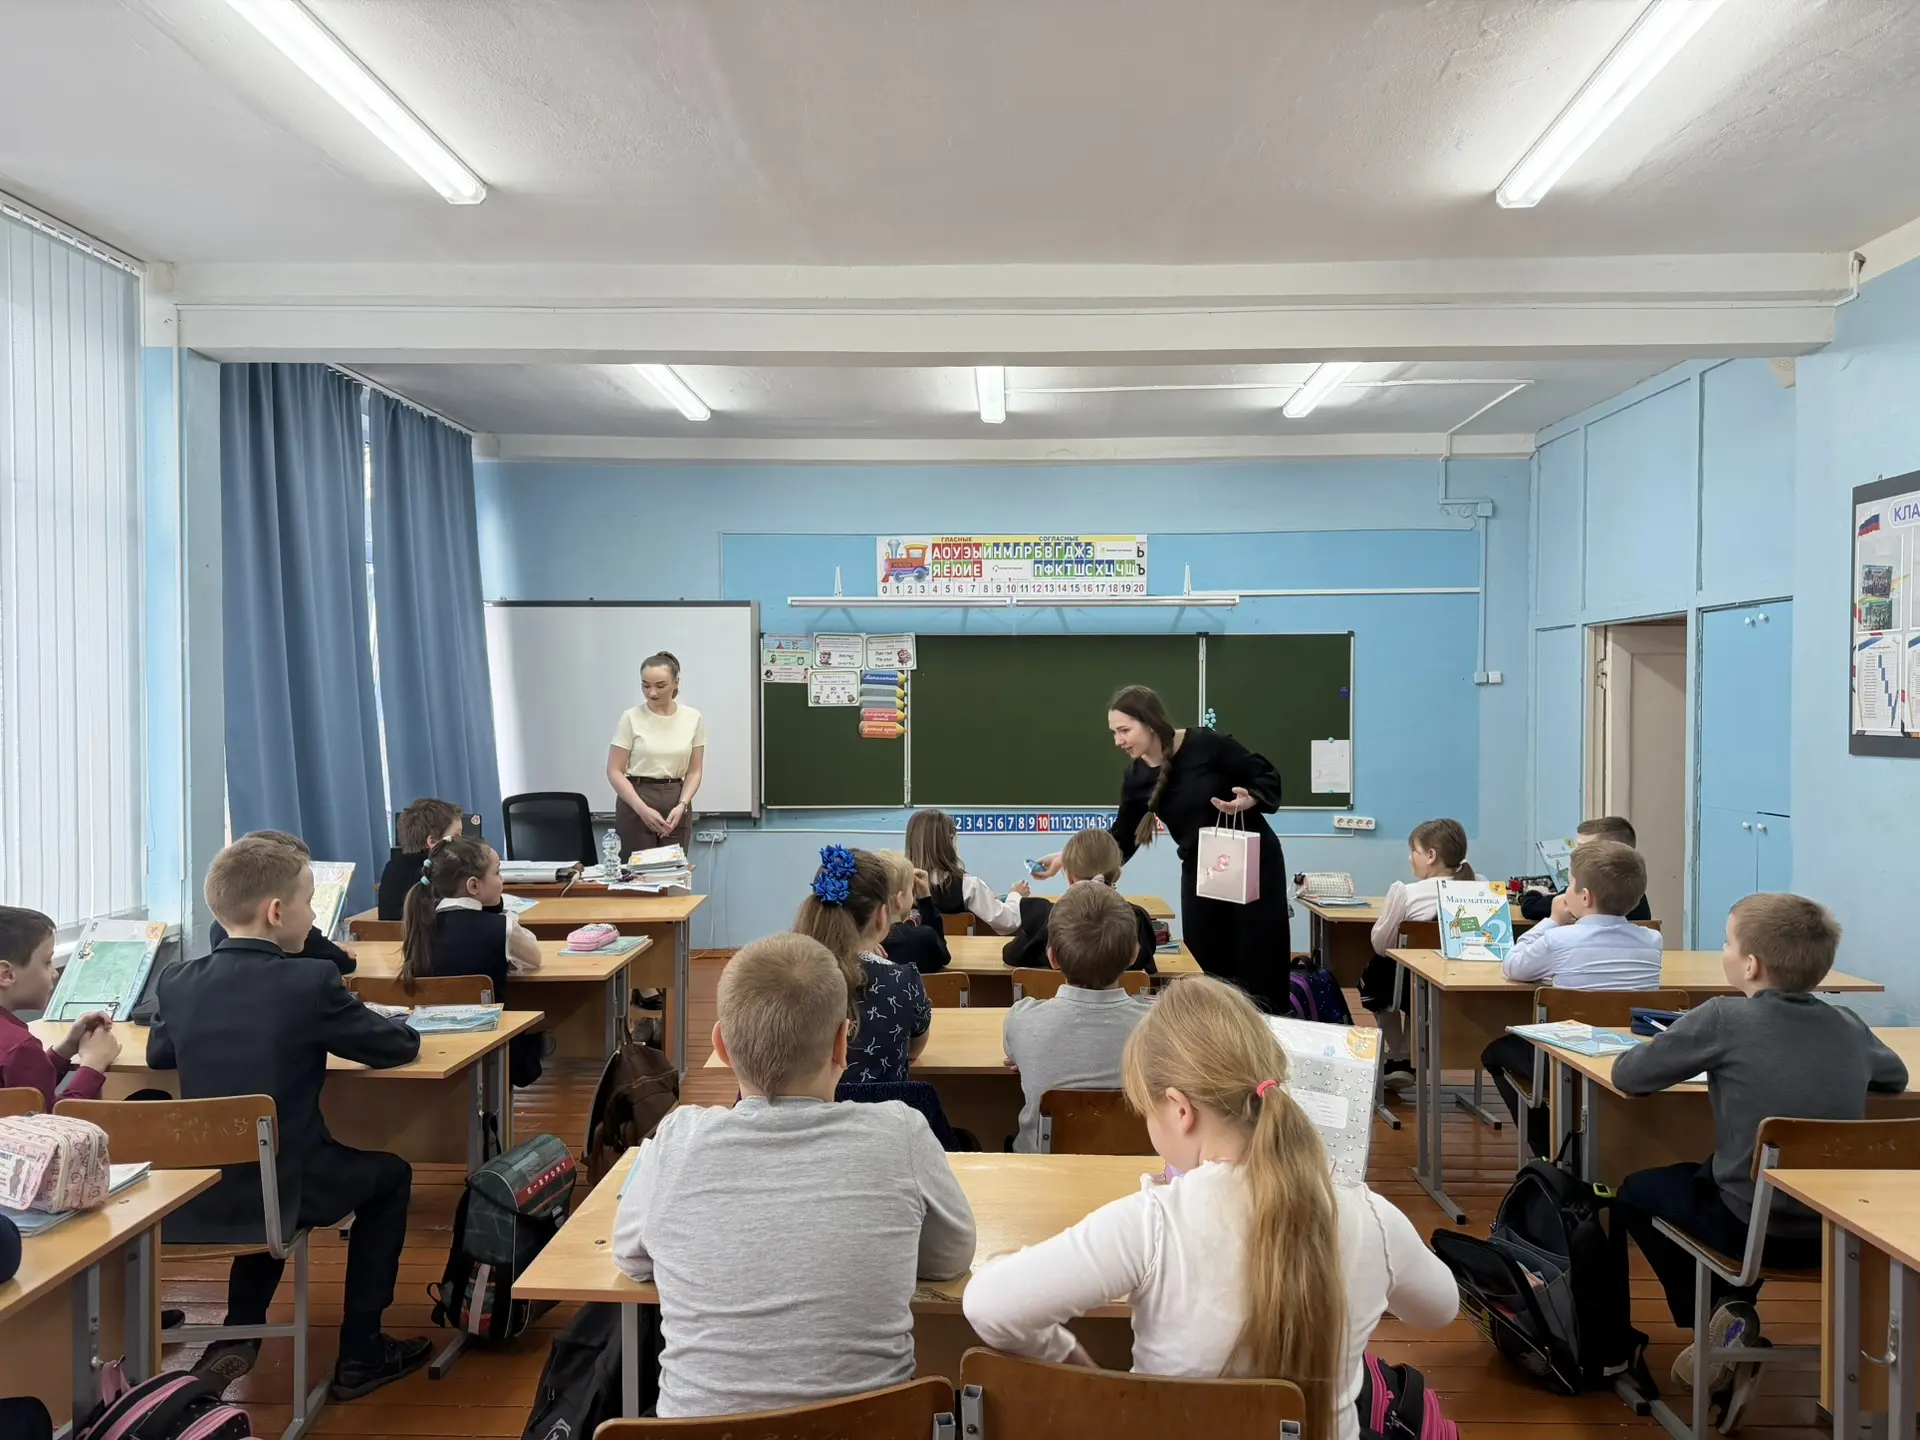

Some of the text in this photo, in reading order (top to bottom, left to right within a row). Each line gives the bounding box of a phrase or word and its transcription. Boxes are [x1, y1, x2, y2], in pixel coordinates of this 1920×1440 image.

[882, 585, 1144, 593] 0 1 2 3 4 5 6 7 8 9 10 11 12 13 14 15 16 17 18 19 20
[955, 817, 962, 829] 2
[966, 817, 972, 829] 3
[976, 817, 983, 829] 4
[987, 817, 993, 829] 5
[997, 817, 1004, 829] 6
[1007, 817, 1014, 829] 7
[1018, 817, 1025, 829] 8
[1028, 817, 1035, 829] 9
[1038, 817, 1047, 829] 10
[1050, 817, 1059, 829] 11
[1061, 817, 1072, 829] 12
[1073, 817, 1083, 829] 13
[1085, 817, 1096, 829] 14
[1097, 816, 1107, 828] 15
[1446, 895, 1500, 905] Математика
[1487, 919, 1511, 949] 2
[526, 1162, 567, 1196] E-SPORT
